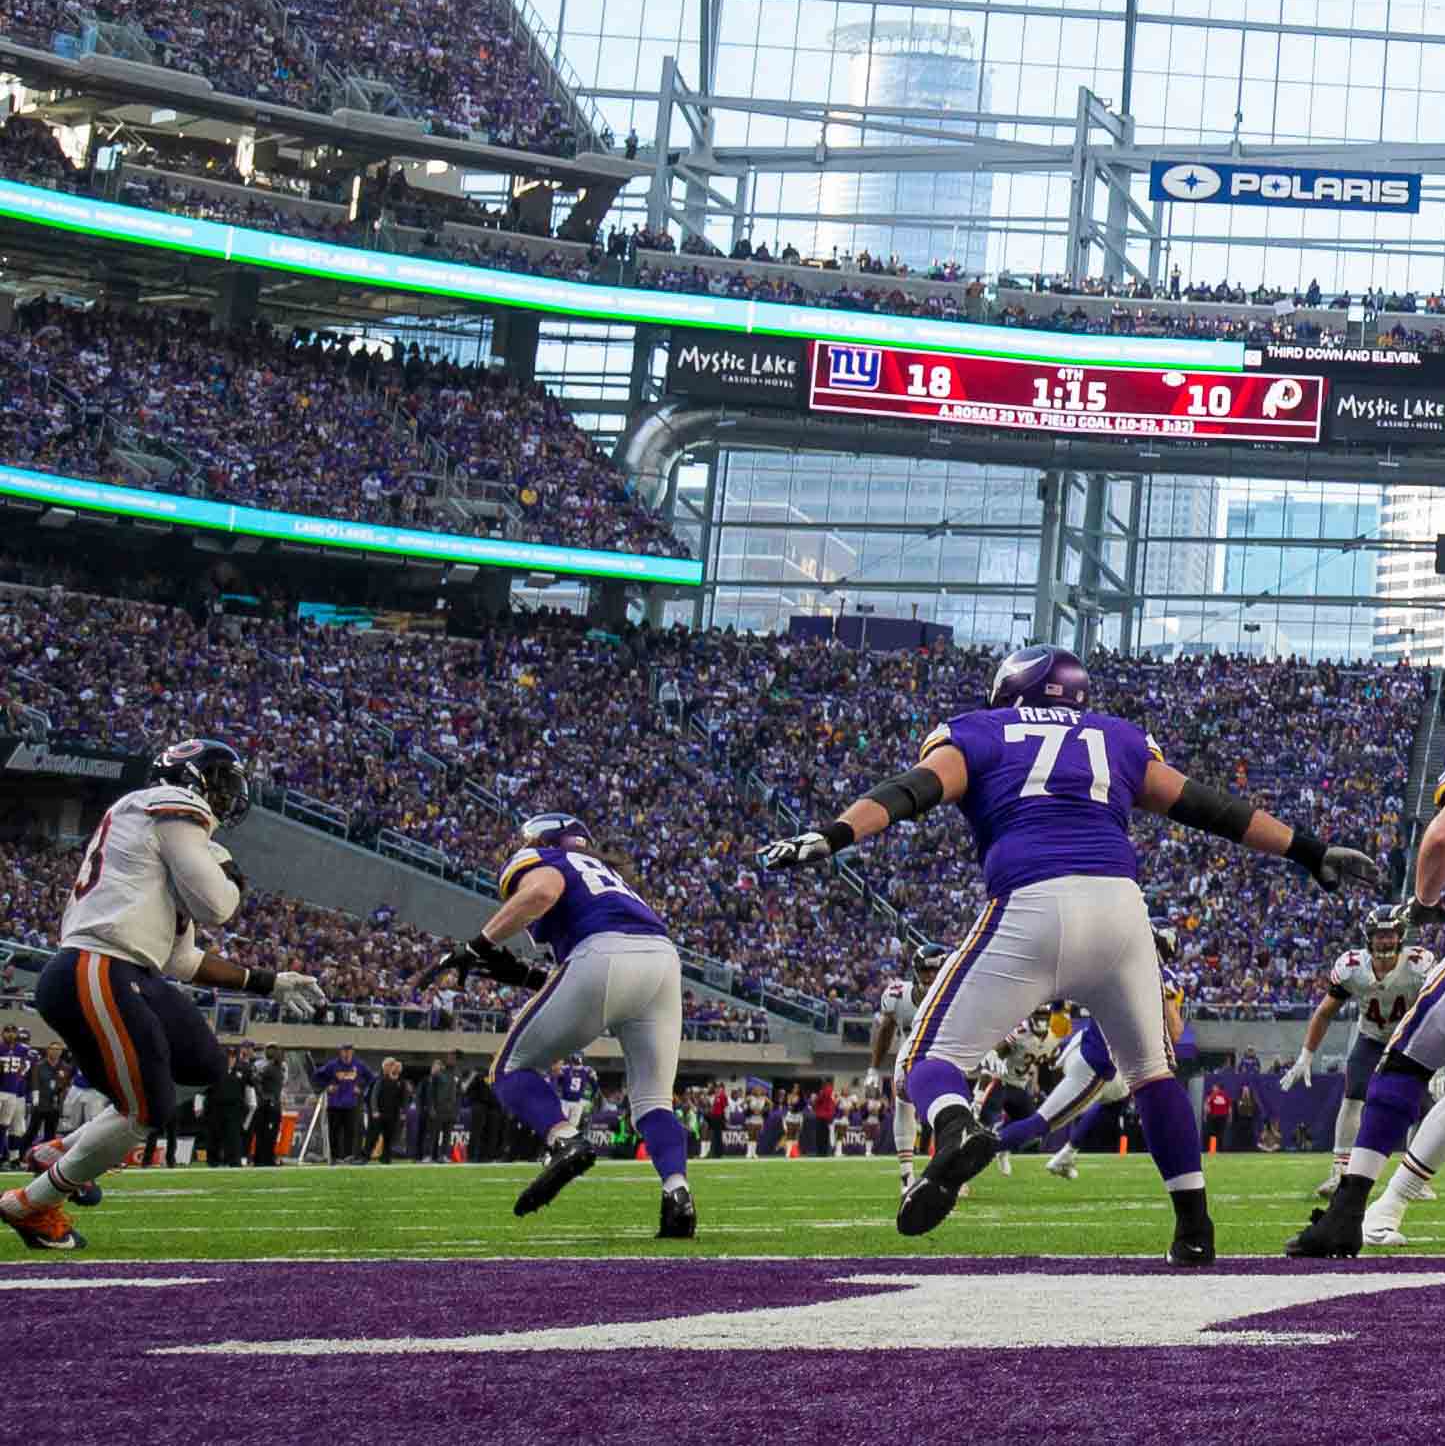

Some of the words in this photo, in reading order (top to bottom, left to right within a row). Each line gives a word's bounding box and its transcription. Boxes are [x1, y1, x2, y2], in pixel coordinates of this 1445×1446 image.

[1230, 172, 1409, 204] POLARIS
[1267, 345, 1303, 360] THIRD
[1305, 347, 1344, 362] DOWN
[1344, 349, 1370, 362] AND
[1372, 350, 1421, 365] ELEVEN.
[721, 373, 757, 385] CASINO
[764, 378, 793, 389] HOTEL
[1057, 368, 1084, 382] 4TH
[907, 364, 951, 398] 18
[1032, 378, 1107, 411] 1:15
[1187, 385, 1232, 416] 10
[998, 410, 1014, 423] 29
[1040, 413, 1076, 428] FIELD
[1078, 415, 1113, 430] GOAL
[1004, 723, 1111, 805] 71
